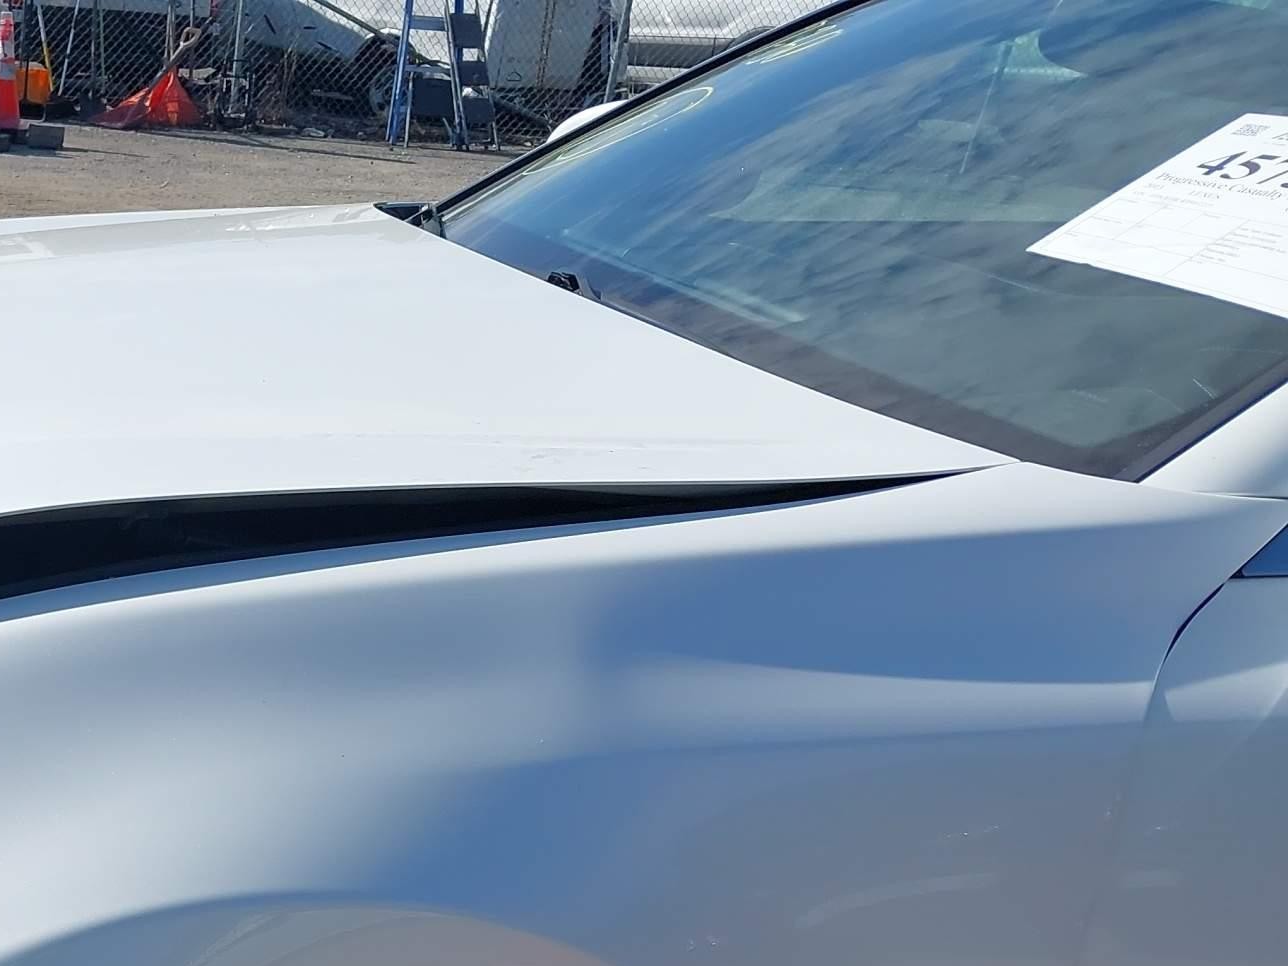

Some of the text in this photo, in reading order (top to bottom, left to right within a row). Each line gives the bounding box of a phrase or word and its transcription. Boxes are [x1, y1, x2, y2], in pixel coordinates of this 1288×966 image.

[1155, 172, 1228, 189] Progressive
[1227, 183, 1283, 200] Casualty
[1196, 150, 1288, 189] 457
